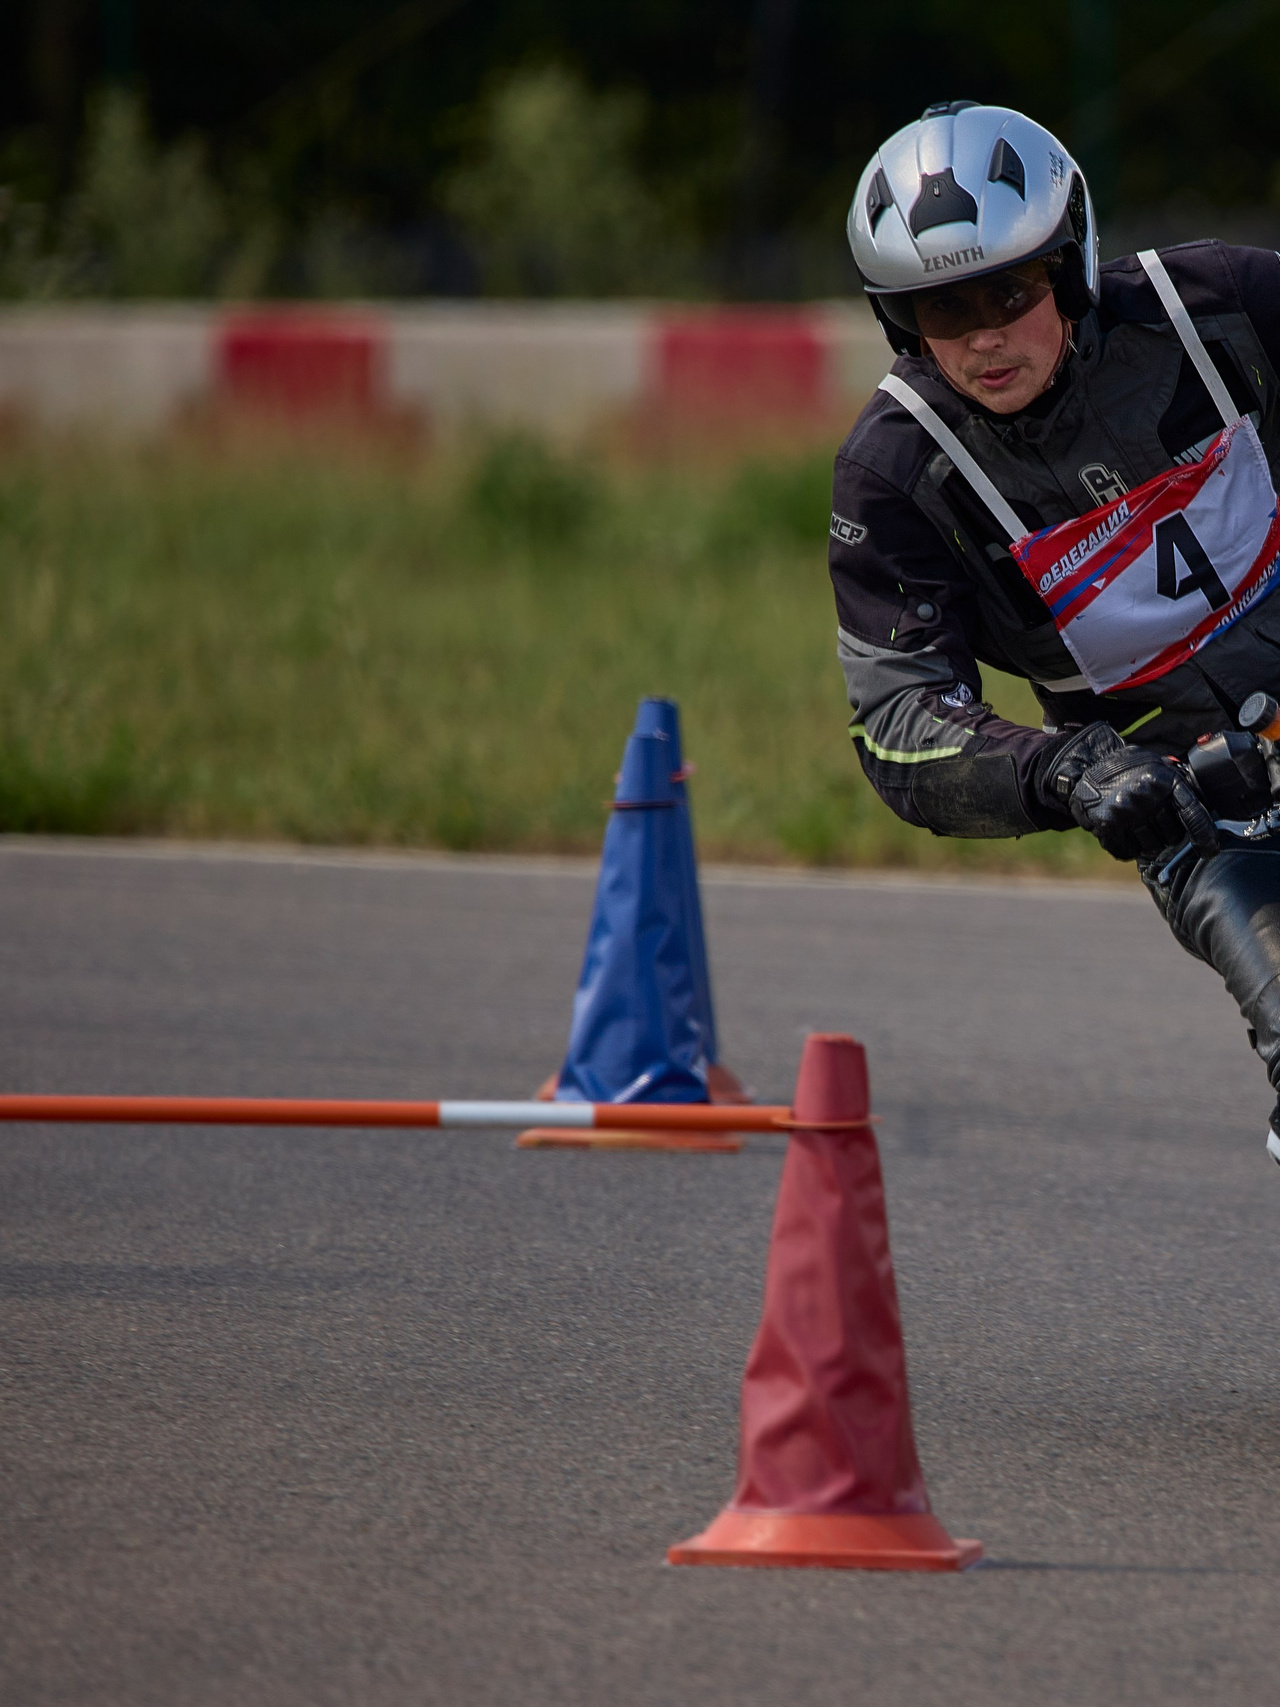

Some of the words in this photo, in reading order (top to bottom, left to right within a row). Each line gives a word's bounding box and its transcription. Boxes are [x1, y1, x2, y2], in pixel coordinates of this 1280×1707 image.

[922, 244, 985, 274] ZENITH
[1038, 499, 1131, 592] ФЕДЕРАЦИЯ
[1152, 508, 1233, 612] 4
